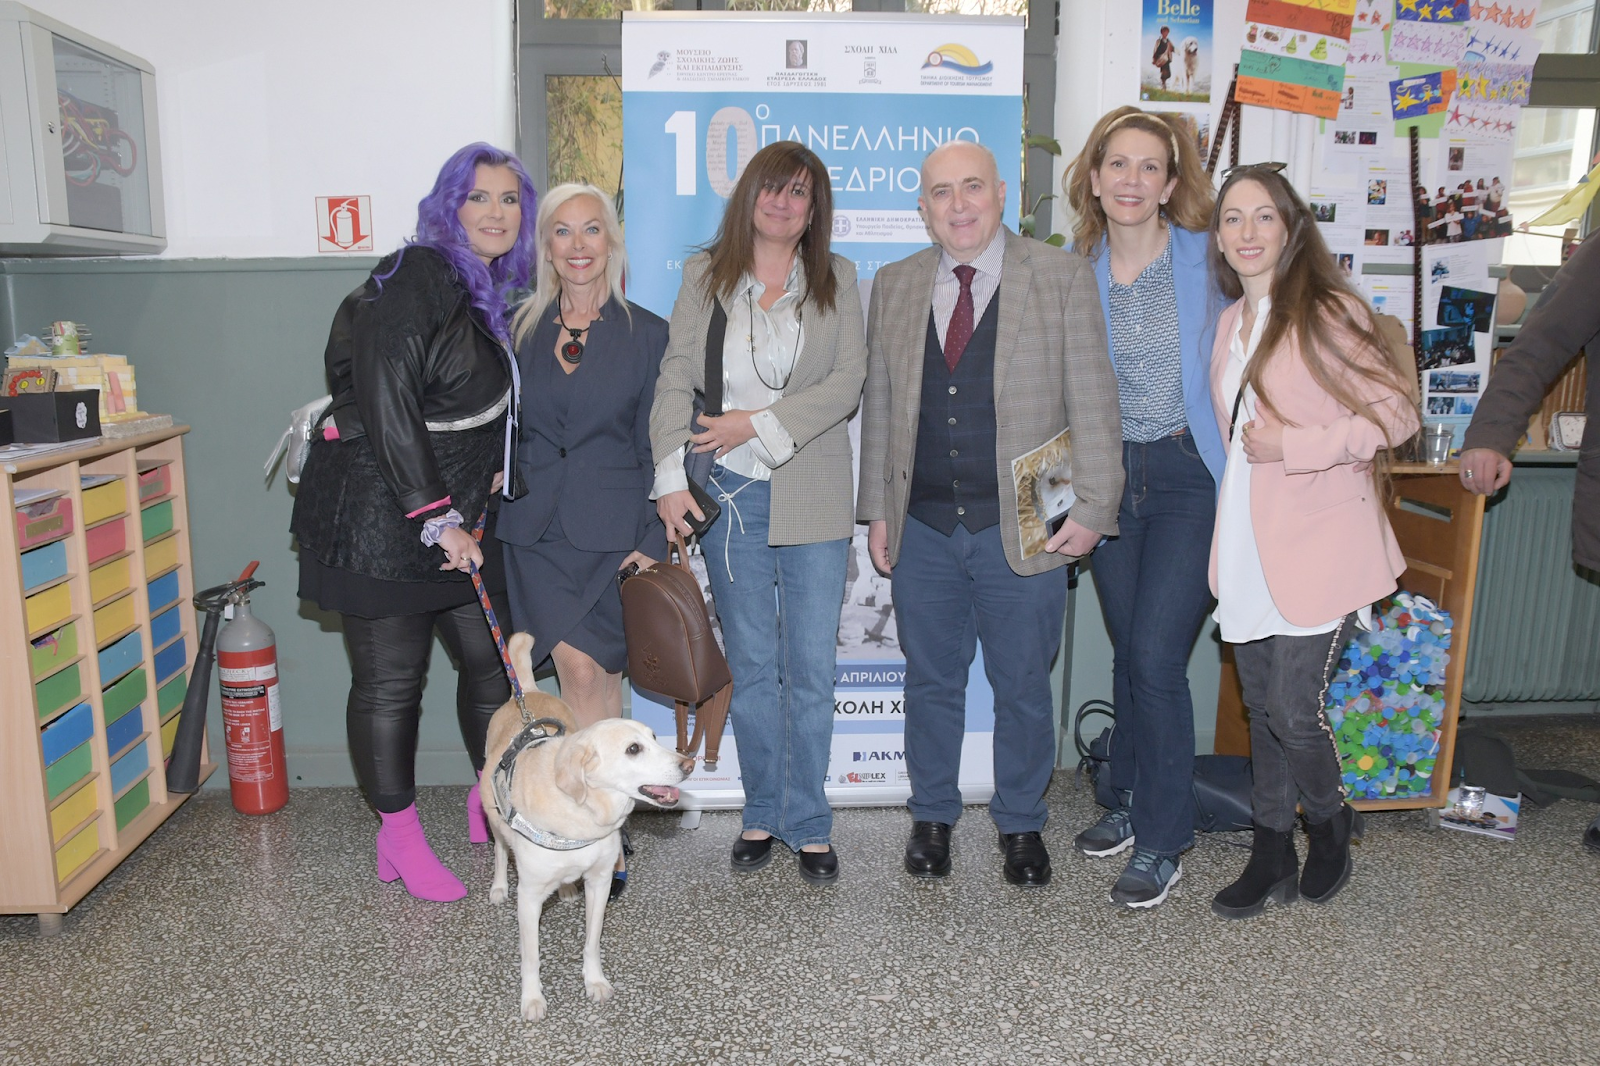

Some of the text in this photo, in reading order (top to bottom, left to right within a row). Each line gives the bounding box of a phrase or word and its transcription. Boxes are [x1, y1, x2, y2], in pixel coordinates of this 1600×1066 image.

[1157, 0, 1200, 16] Belle
[844, 45, 898, 54] ΣΧΟΛΗ ΧΙΛΛ
[830, 166, 922, 193] ΕΔΡΙΟ
[840, 671, 906, 683] ΑΠΡΙΛΙΟΥ
[834, 701, 906, 714] ΧΟΛΗ ΧΙ
